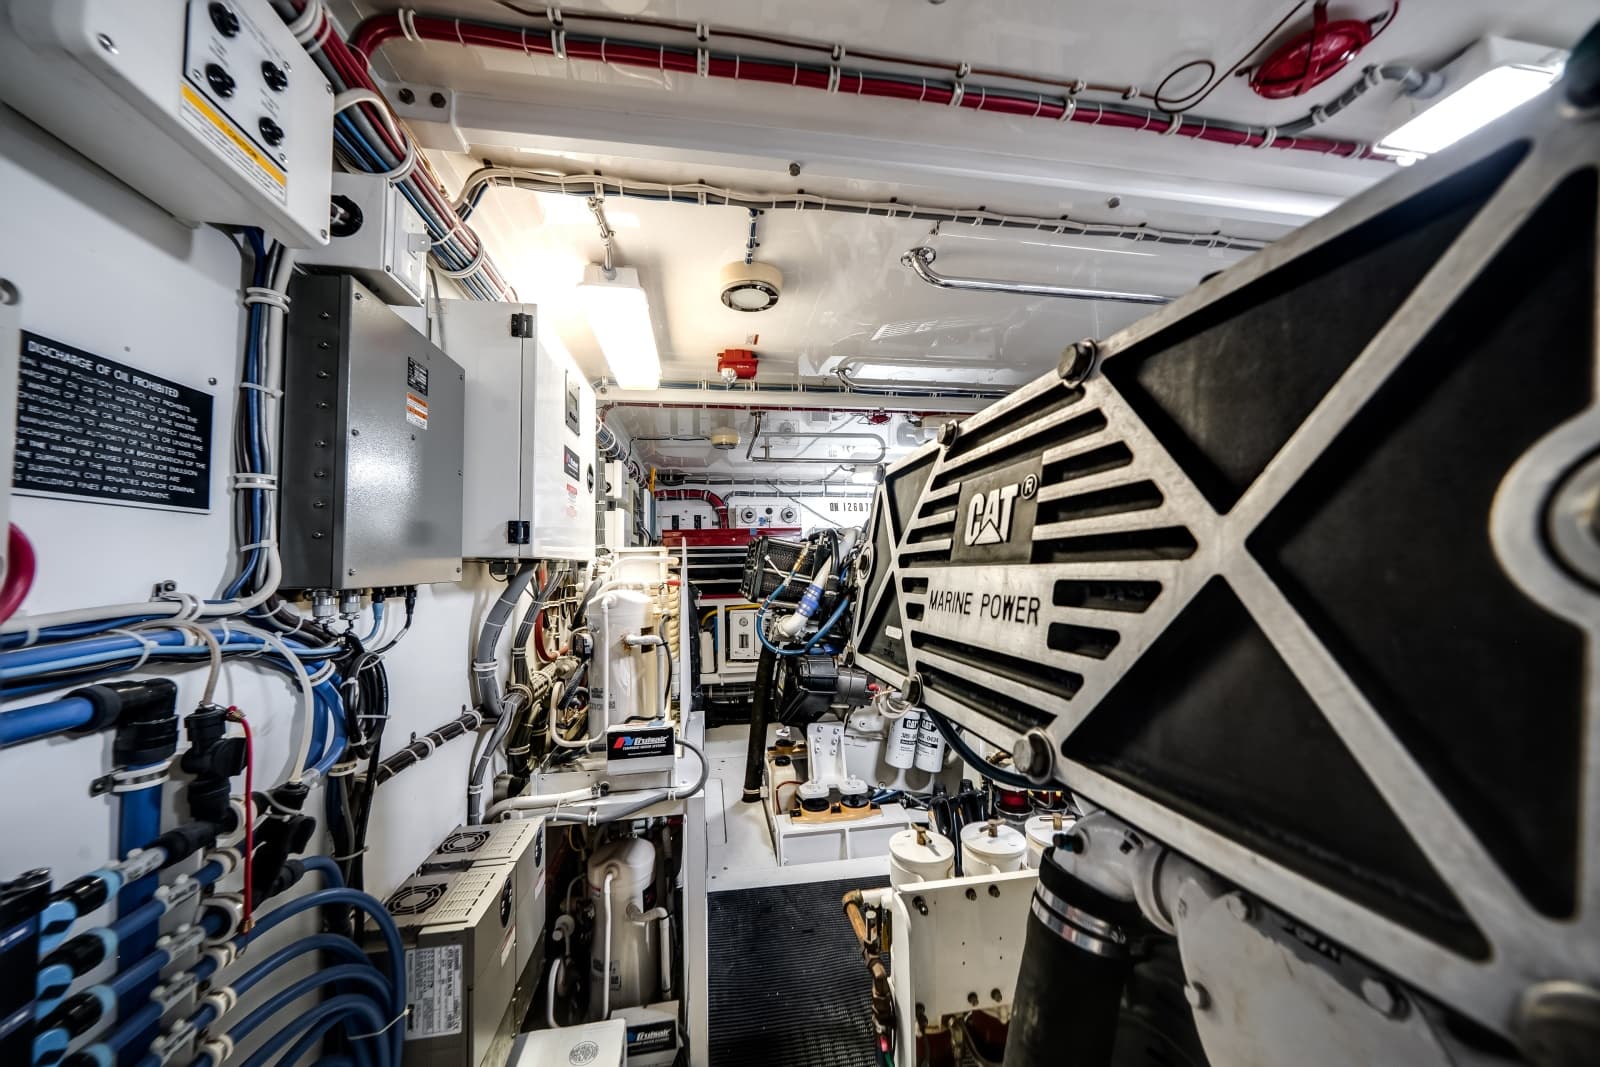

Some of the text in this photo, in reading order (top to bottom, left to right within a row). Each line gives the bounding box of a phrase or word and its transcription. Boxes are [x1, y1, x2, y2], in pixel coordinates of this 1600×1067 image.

[27, 340, 93, 371] DISCHARGE
[95, 363, 111, 376] OF
[113, 369, 129, 382] OIL
[132, 375, 178, 398] PROHIBITED
[49, 375, 62, 385] OF
[81, 385, 94, 394] OR
[115, 384, 146, 399] CONTROL
[148, 394, 160, 403] ACT
[18, 390, 72, 410] ONTIGUOUS
[101, 411, 112, 420] OR
[156, 425, 177, 436] AFFECT
[27, 404, 80, 423] BELONGING
[62, 390, 75, 400] OF
[78, 395, 94, 404] THE
[160, 417, 172, 425] THE
[63, 435, 96, 447] CAUSES
[195, 461, 205, 469] THE
[127, 438, 137, 446] OF
[140, 441, 152, 449] THE
[73, 459, 85, 467] OF
[87, 461, 103, 470] THE
[78, 449, 91, 457] OR
[93, 452, 121, 462] CAUSES
[24, 475, 74, 487] INCLUDING
[76, 481, 99, 490] FINES
[101, 484, 118, 492] AND
[843, 502, 873, 512] 12607
[965, 483, 1018, 546] CAT
[929, 590, 1040, 626] MARINE POWER
